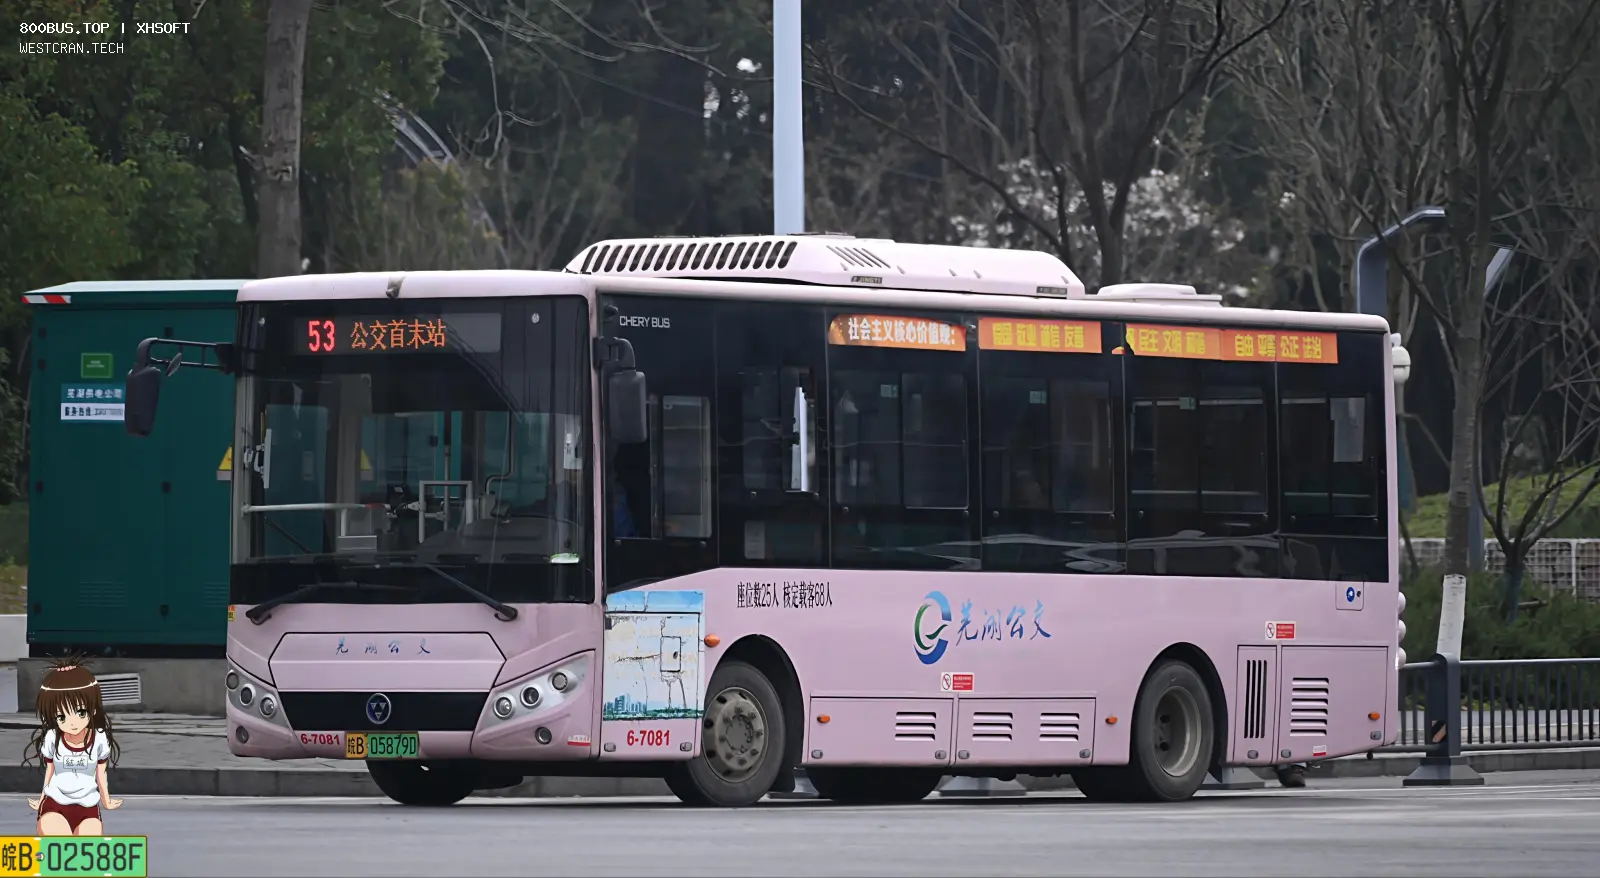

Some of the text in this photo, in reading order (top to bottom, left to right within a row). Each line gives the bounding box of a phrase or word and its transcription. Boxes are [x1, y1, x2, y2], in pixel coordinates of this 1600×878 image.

[350, 318, 446, 350] 公交首末站
[619, 315, 670, 328] CHERY BUS
[308, 320, 335, 351] 53
[1235, 333, 1254, 357] 自由
[737, 581, 833, 609] 座位数25人 核定载客68人
[956, 599, 1052, 646] 芜湖公交
[300, 733, 341, 746] 6-7081
[627, 730, 671, 747] 6-7081
